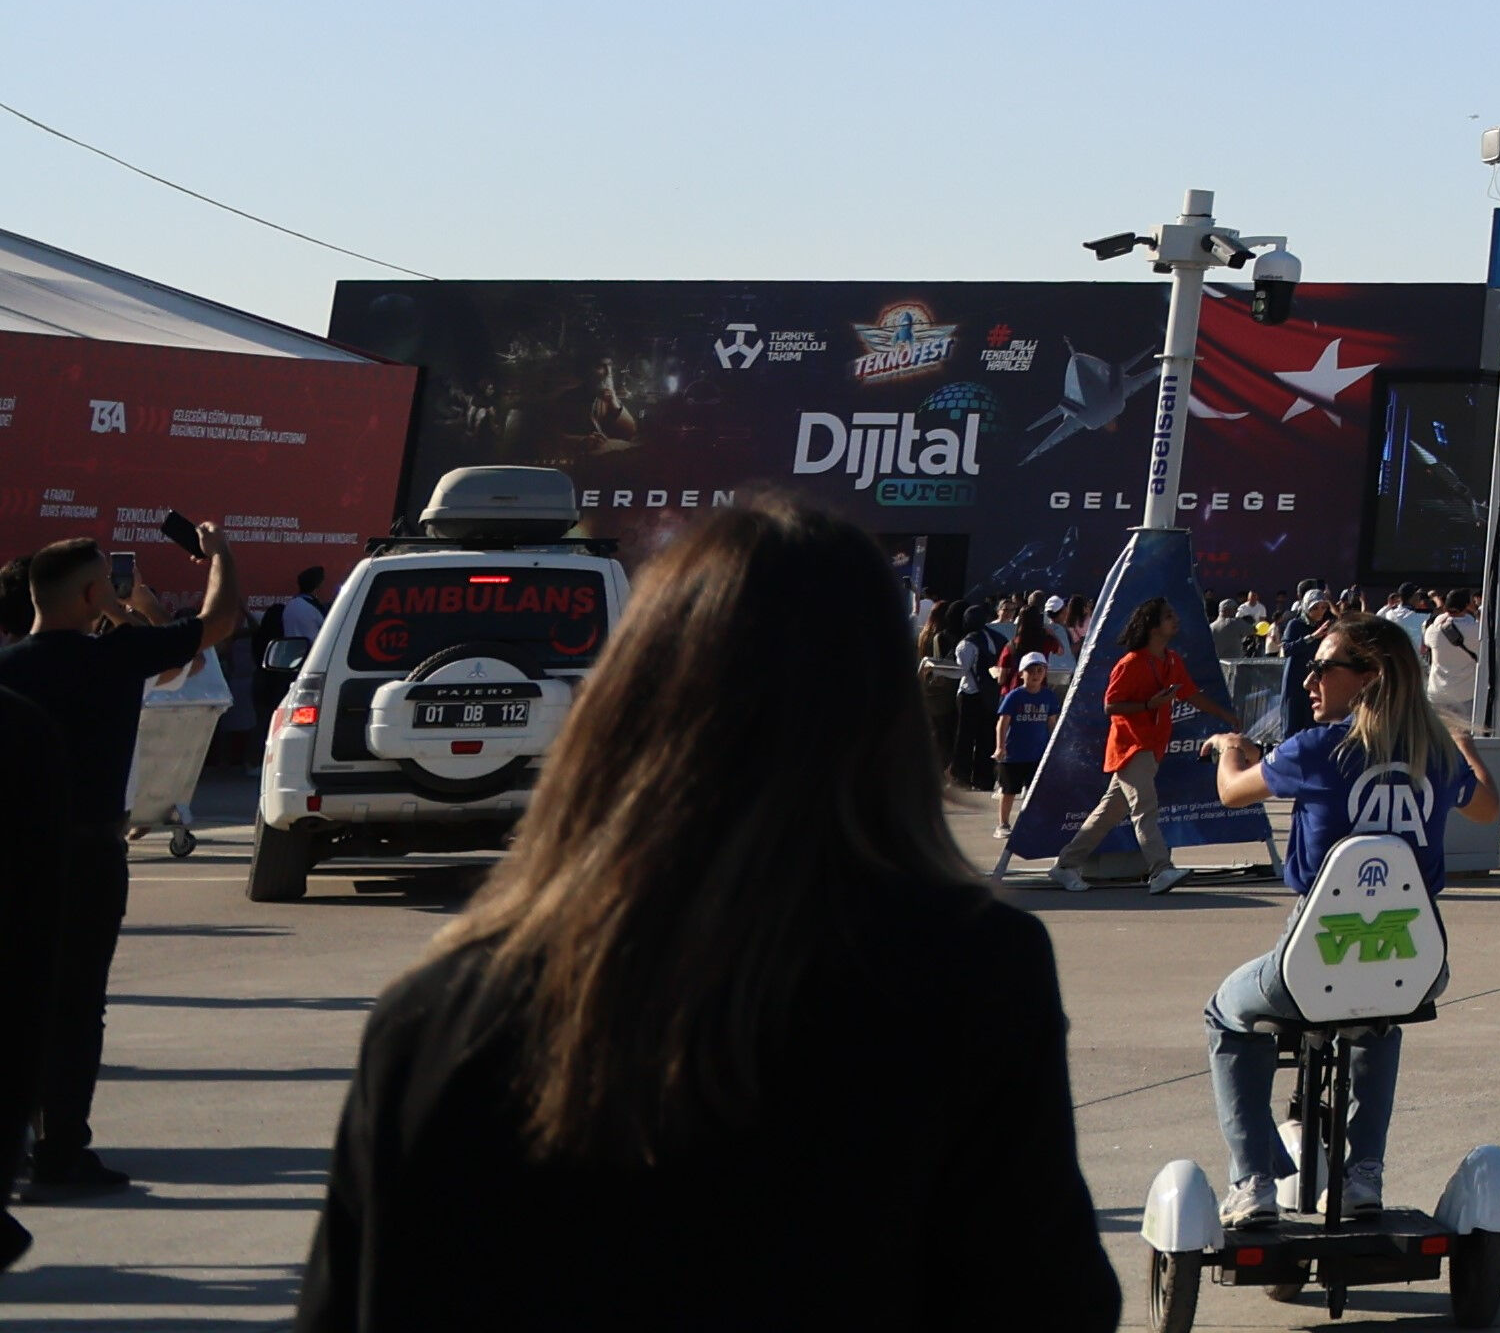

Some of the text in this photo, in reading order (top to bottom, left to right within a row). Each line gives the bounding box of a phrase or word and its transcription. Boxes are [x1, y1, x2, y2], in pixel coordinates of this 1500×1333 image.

[855, 338, 953, 378] TEKNOFEST
[1147, 374, 1179, 496] aselsan
[793, 412, 981, 490] Dijital
[581, 489, 1297, 512] ERDEN GELCEĞE
[882, 482, 973, 502] evren
[375, 586, 597, 620] AMBULANŞ
[379, 631, 409, 648] 112
[437, 688, 513, 696] PAJERO
[425, 706, 444, 723] 01
[501, 704, 527, 721] 112
